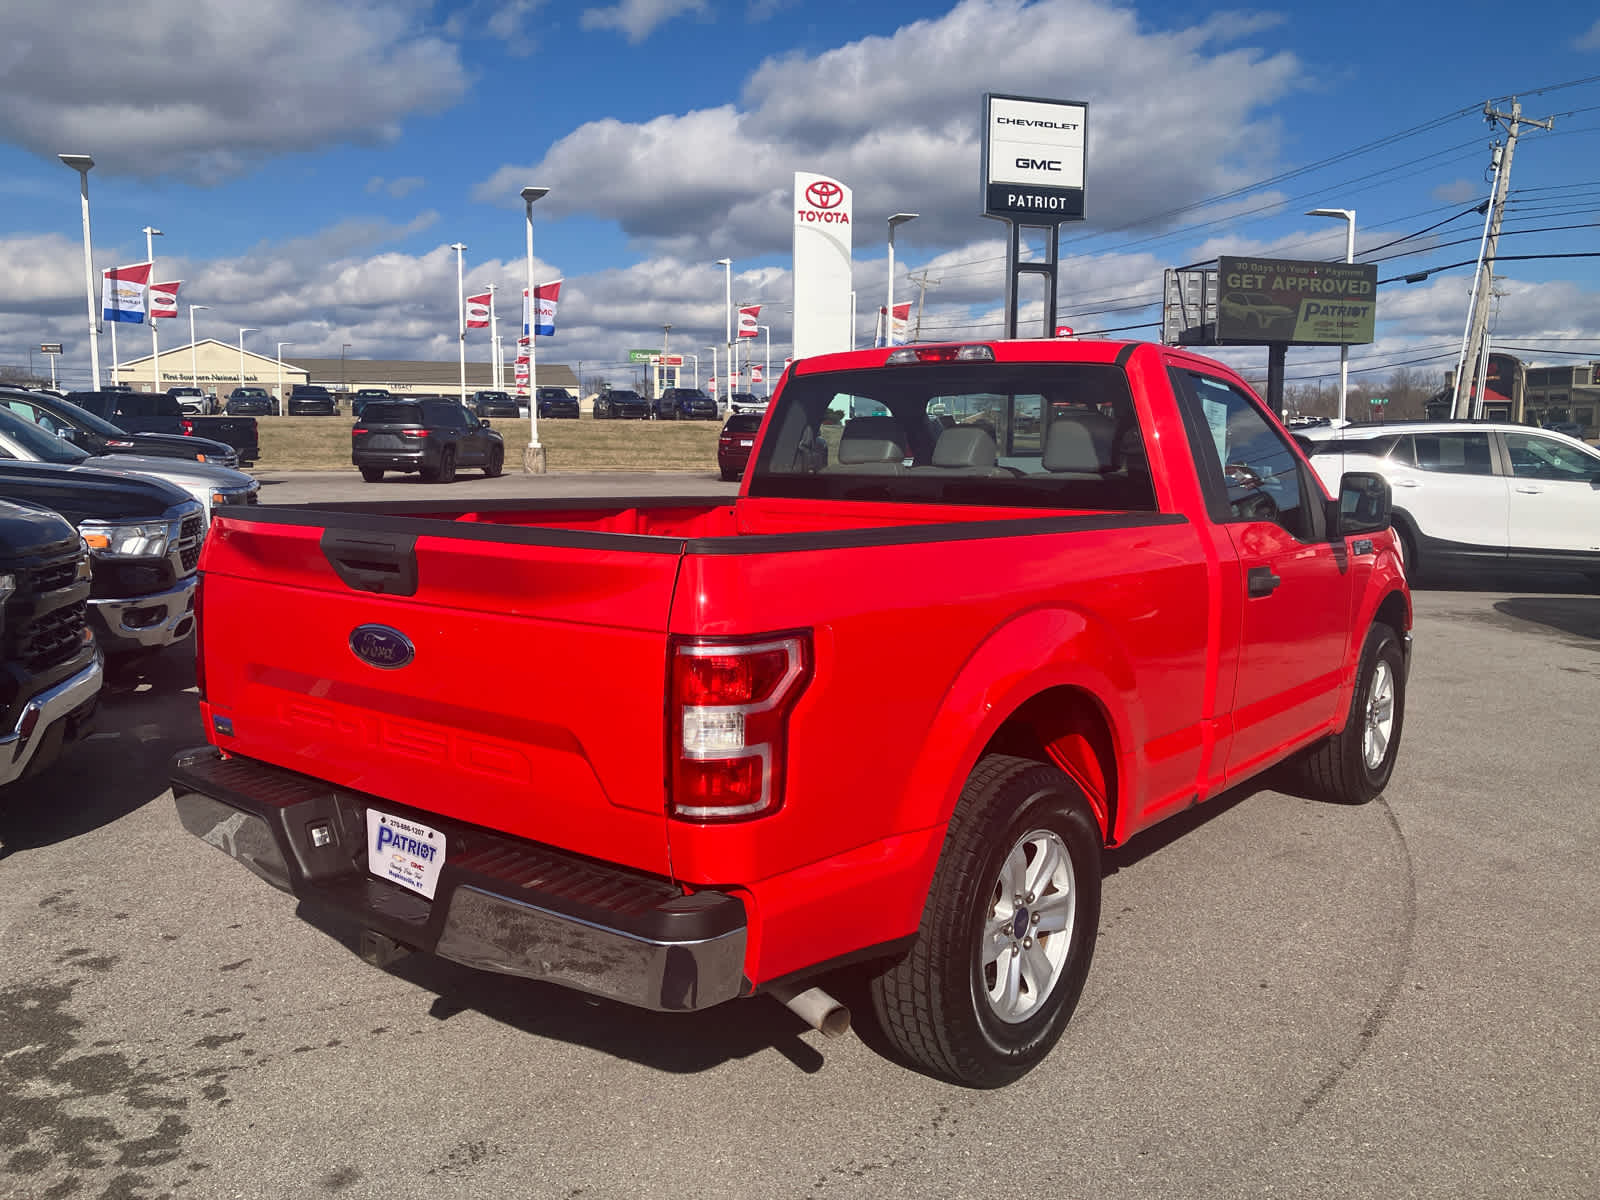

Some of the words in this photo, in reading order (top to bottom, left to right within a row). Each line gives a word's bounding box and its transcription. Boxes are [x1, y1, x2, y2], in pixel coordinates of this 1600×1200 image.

[997, 117, 1079, 131] CHEVROLET
[1016, 158, 1062, 171] GMC
[1008, 194, 1066, 209] PATRIOT
[798, 211, 849, 224] TOYOTA
[1226, 274, 1266, 289] GET
[1272, 277, 1371, 295] APPROVED
[1304, 302, 1369, 322] PATRIOT
[361, 632, 396, 660] Ford
[377, 825, 437, 862] PATRIOT
[410, 861, 424, 872] GMC
